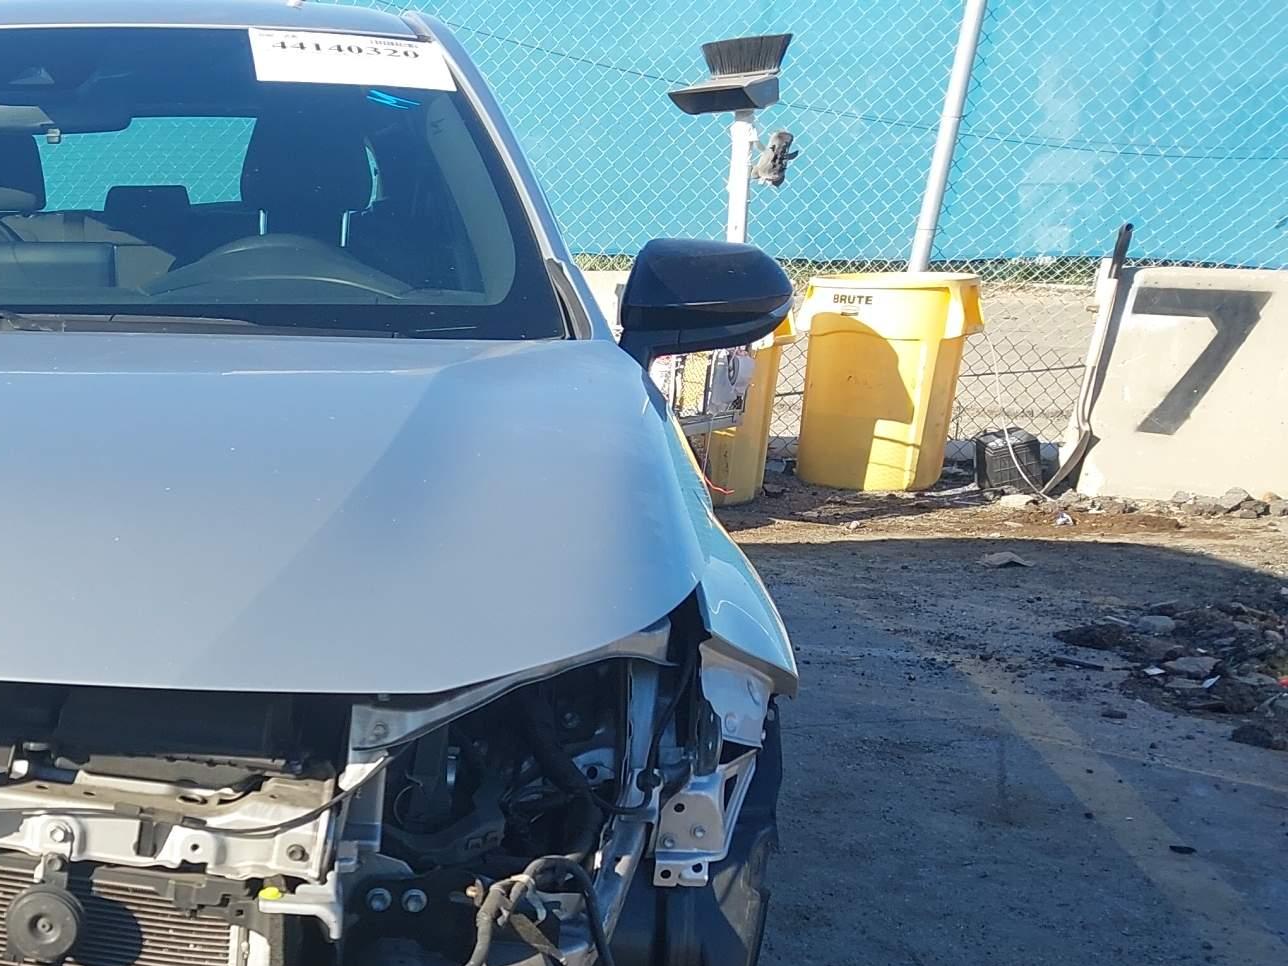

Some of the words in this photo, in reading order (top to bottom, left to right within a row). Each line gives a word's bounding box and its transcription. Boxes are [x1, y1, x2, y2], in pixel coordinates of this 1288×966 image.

[272, 41, 420, 59] 44140320
[833, 294, 873, 305] BRUTE
[1132, 287, 1274, 436] 7
